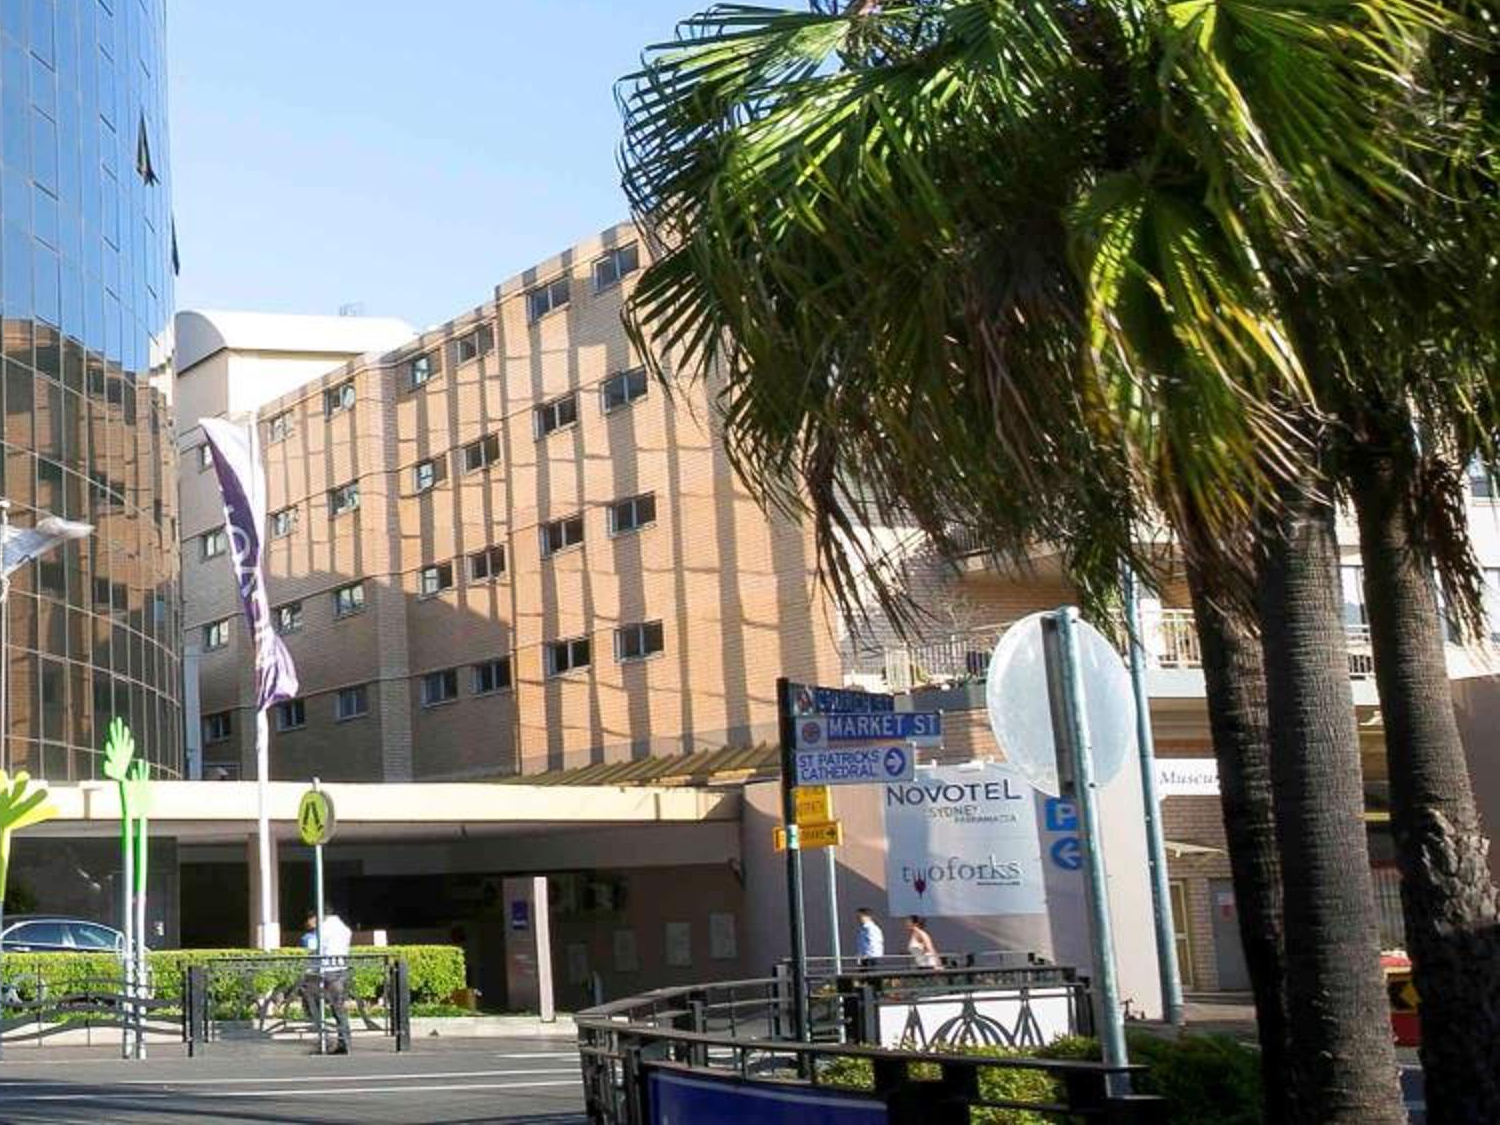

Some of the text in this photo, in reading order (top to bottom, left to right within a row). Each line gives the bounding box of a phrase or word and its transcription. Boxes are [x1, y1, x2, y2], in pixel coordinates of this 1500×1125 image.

[829, 714, 935, 737] MARKET ST
[799, 749, 882, 768] ST PATRICKS
[800, 763, 874, 780] CATHEDRAL
[1159, 770, 1219, 786] Museu
[886, 779, 1022, 806] NOVOTEL
[929, 804, 980, 818] SYDNEY
[902, 851, 1021, 893] twoforks
